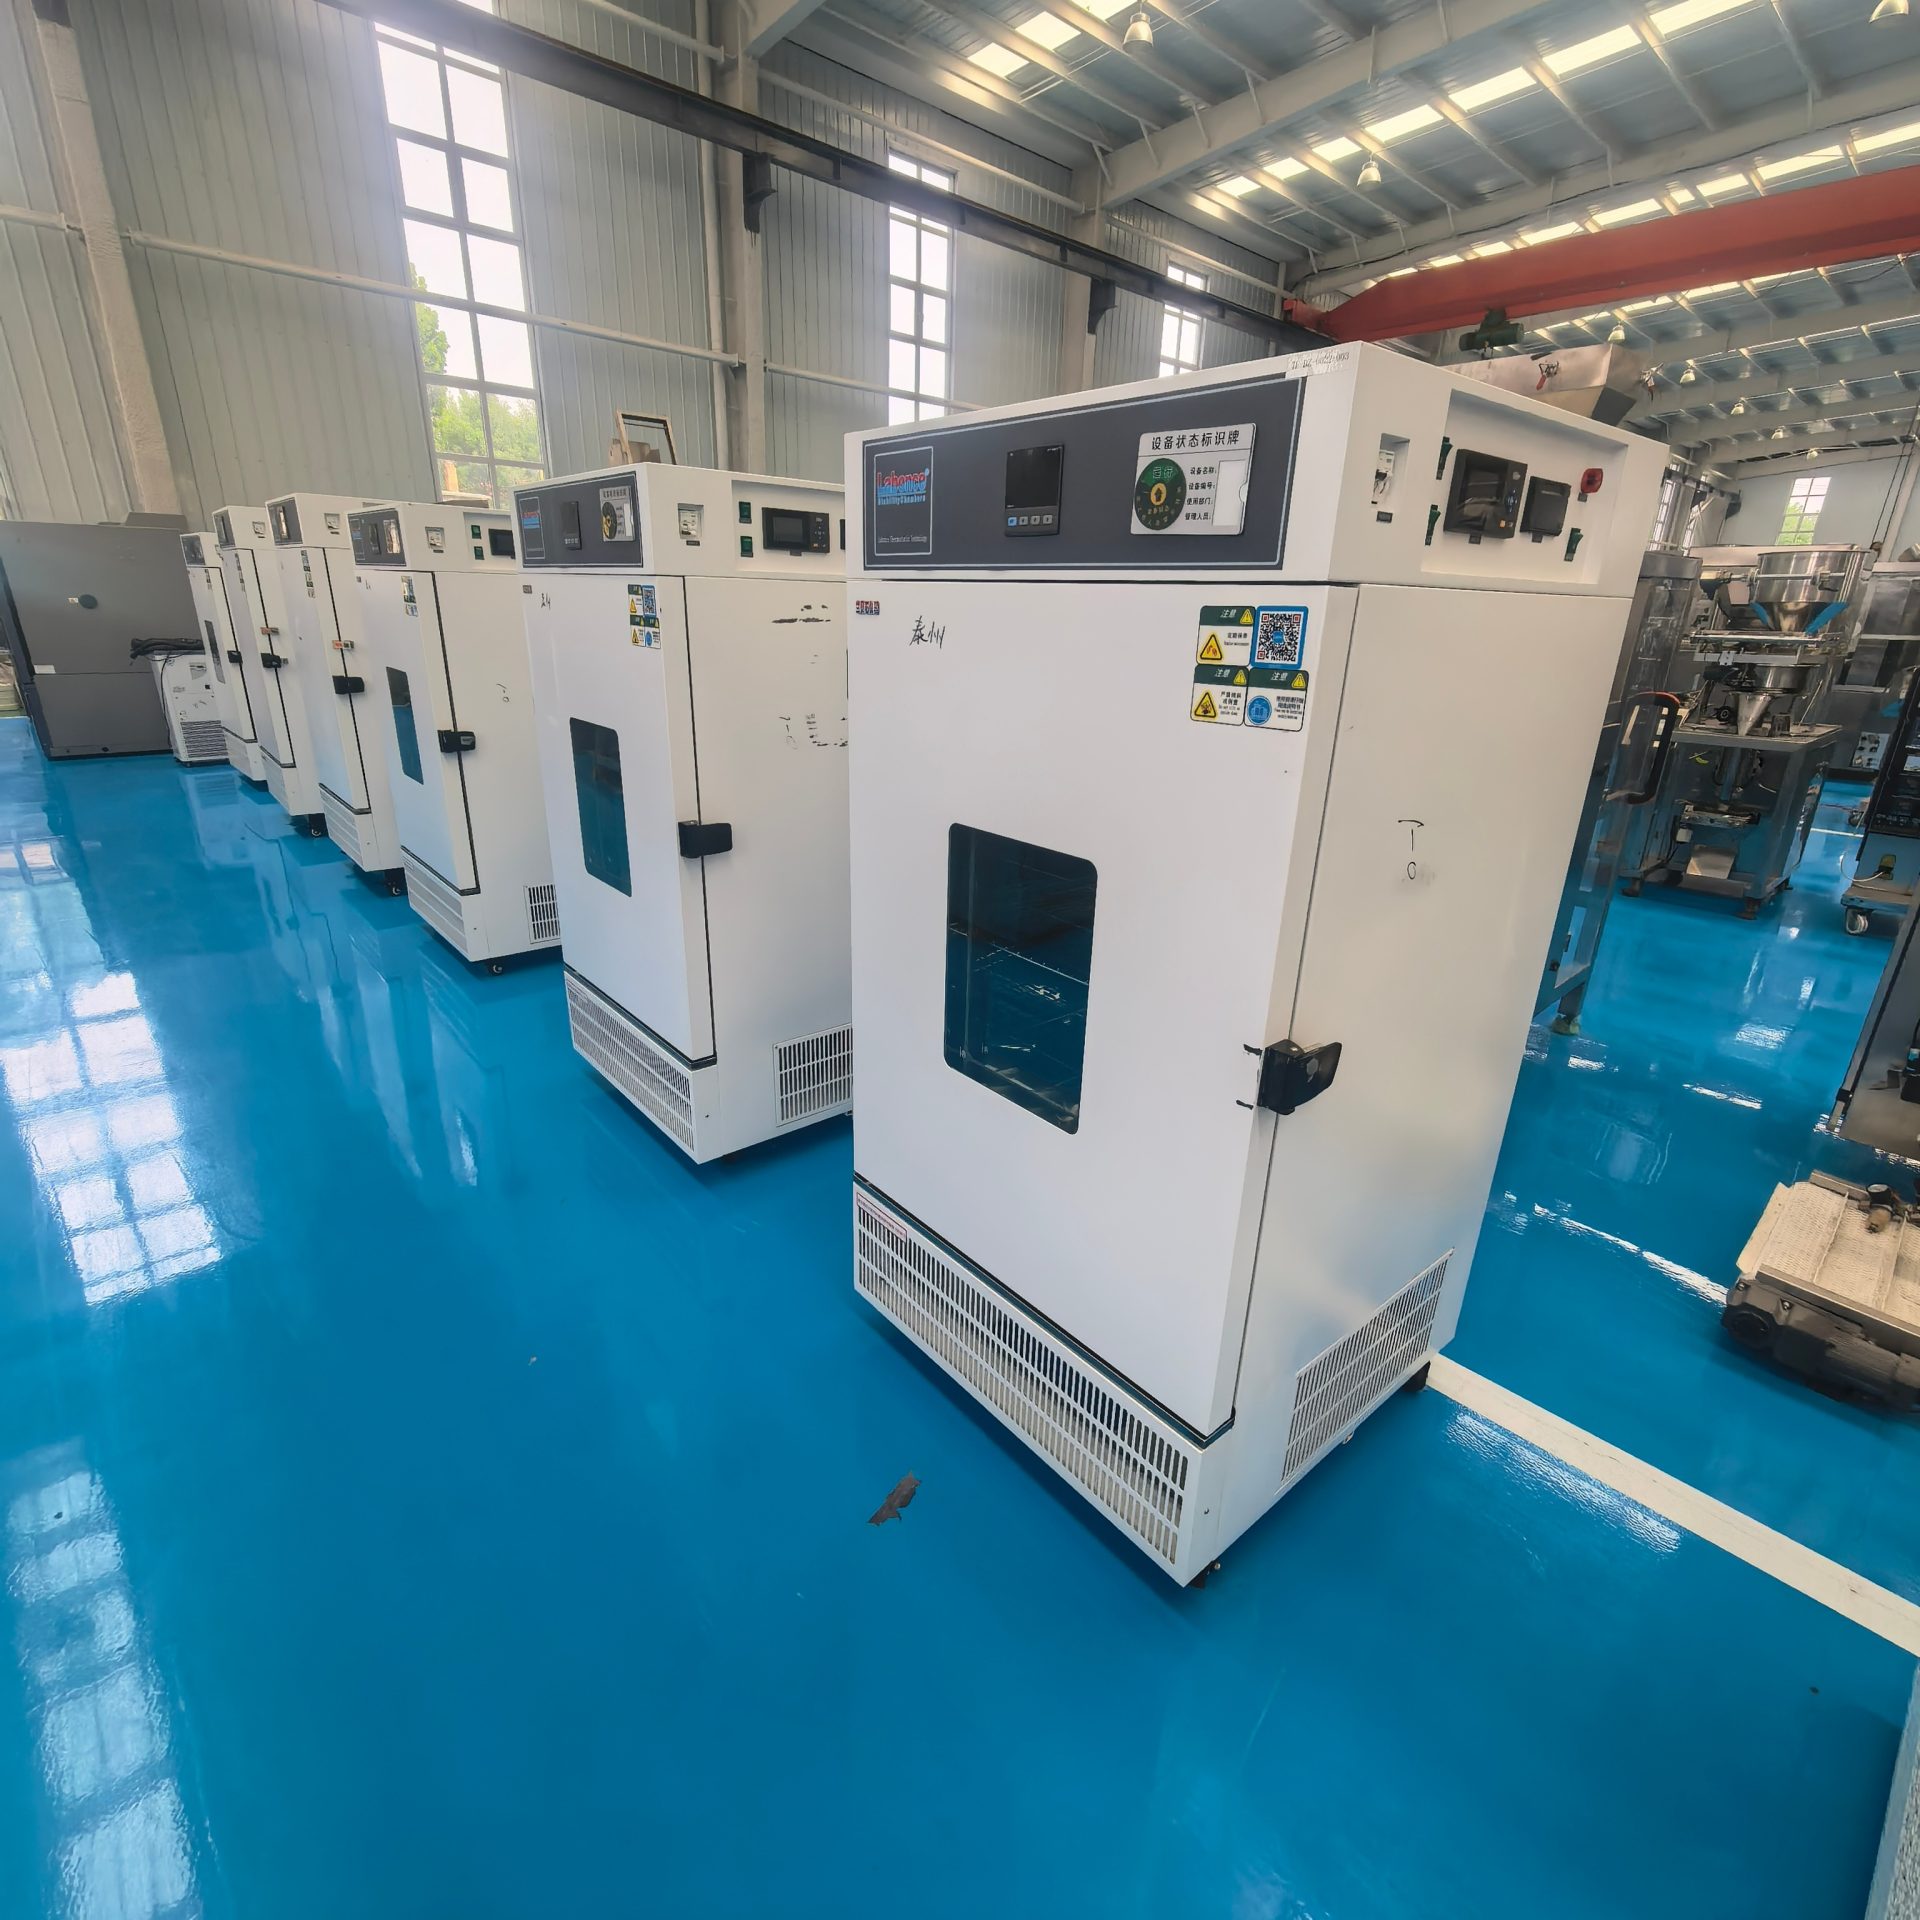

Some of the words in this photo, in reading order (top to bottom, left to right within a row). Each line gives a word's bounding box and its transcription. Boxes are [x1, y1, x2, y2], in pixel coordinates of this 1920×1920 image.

[1151, 430, 1240, 450] 设备状态标识牌
[1220, 609, 1237, 618] 注意
[1214, 669, 1231, 678] 注意
[1271, 672, 1288, 681] 注意
